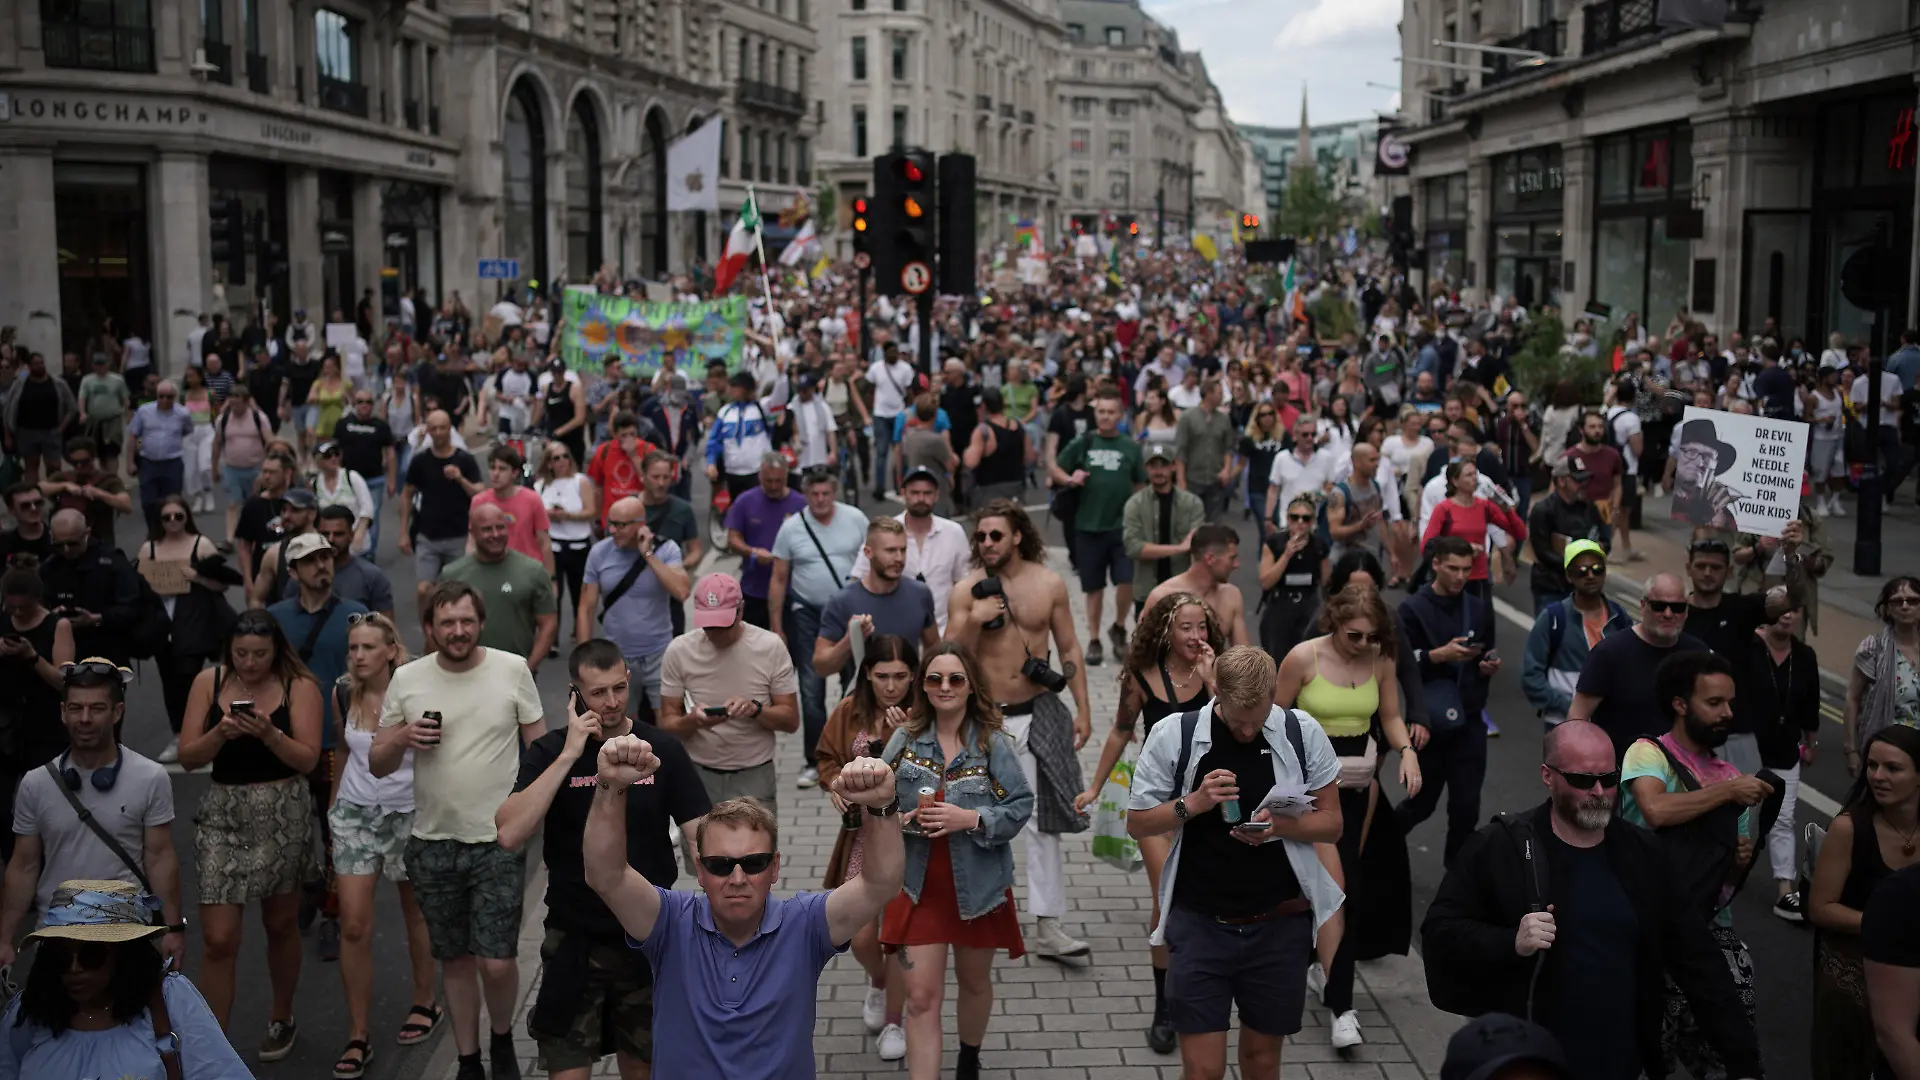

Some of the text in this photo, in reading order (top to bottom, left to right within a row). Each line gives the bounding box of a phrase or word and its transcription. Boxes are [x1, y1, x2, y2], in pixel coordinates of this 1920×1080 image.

[14, 99, 191, 124] LONGCHAMP
[1755, 427, 1793, 443] DR EVIL
[1759, 443, 1786, 457] & HIS
[1751, 458, 1790, 473] NEEDLE
[1743, 471, 1795, 489] IS COMING
[1756, 489, 1777, 502] FOR
[1739, 502, 1791, 519] YOUR KIDS
